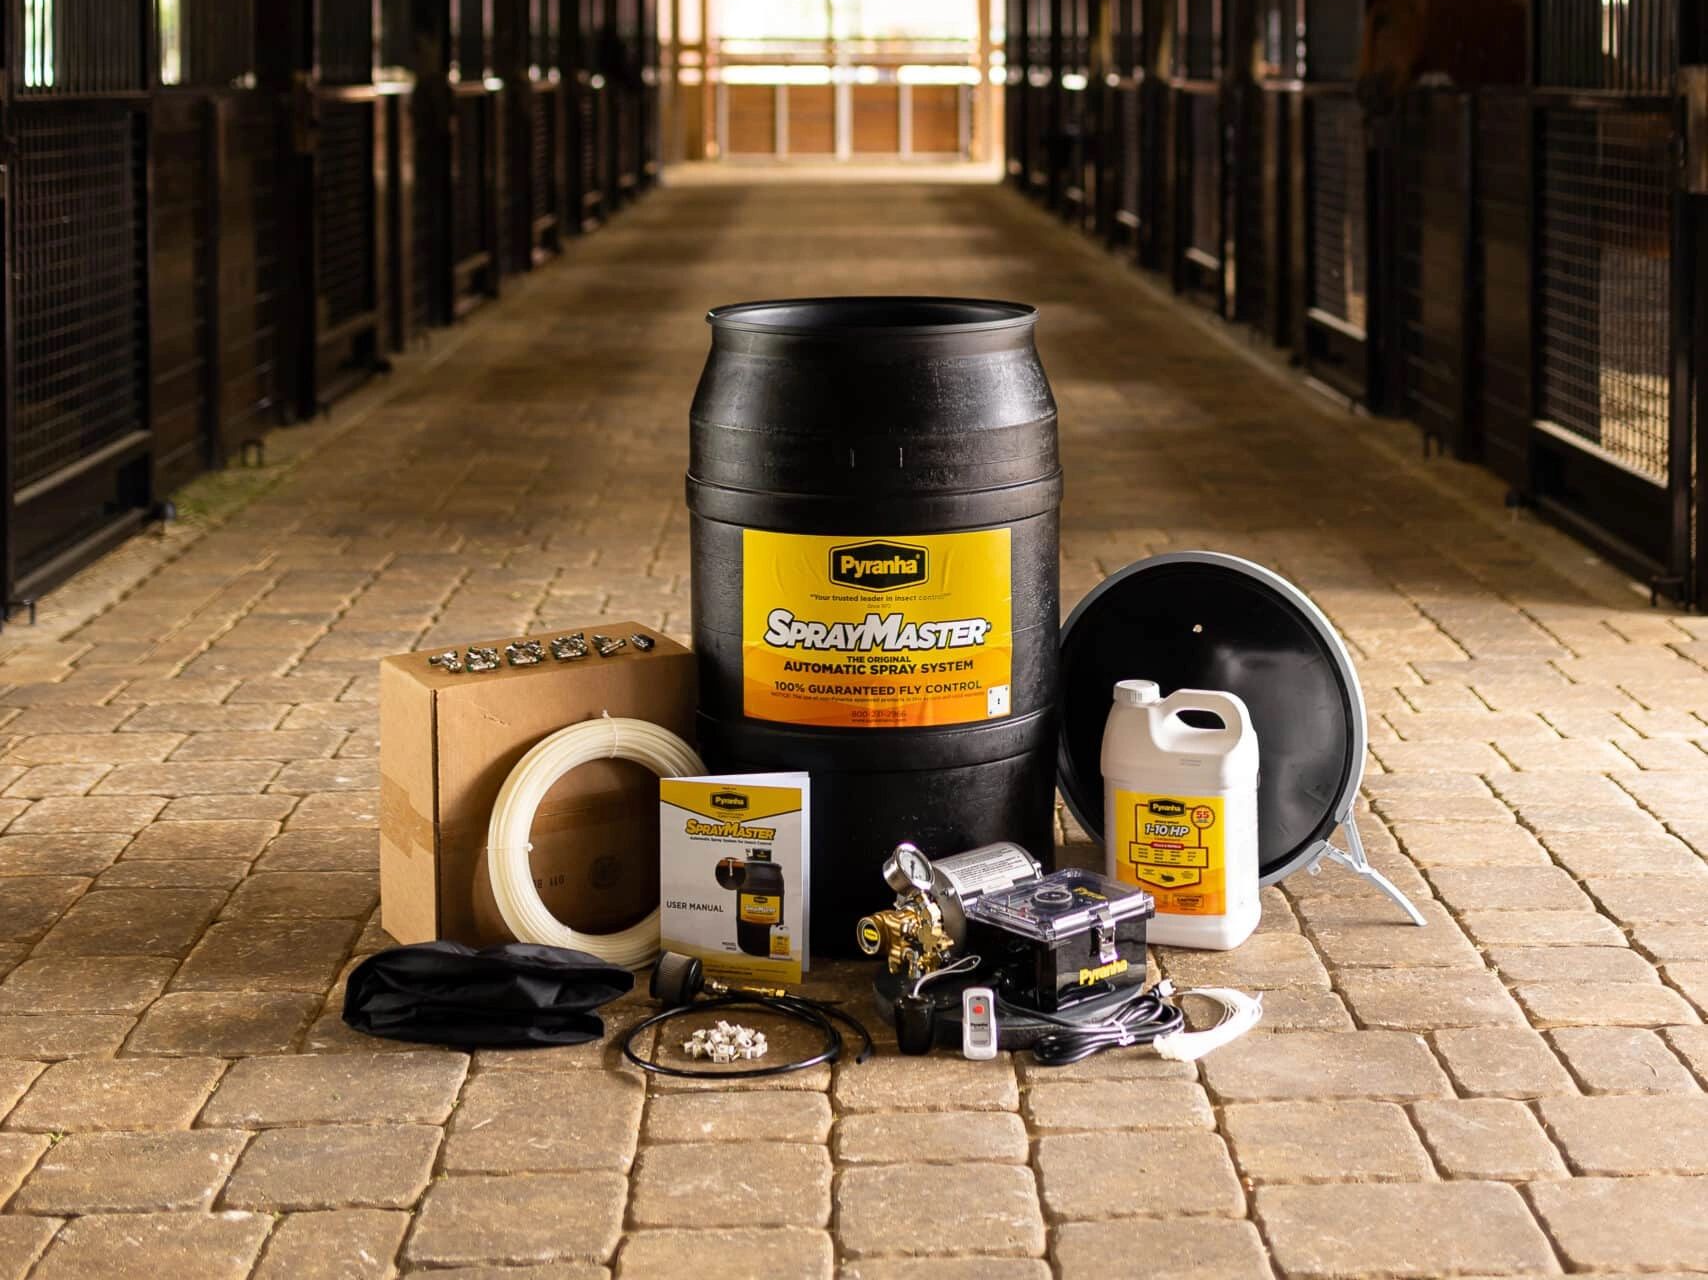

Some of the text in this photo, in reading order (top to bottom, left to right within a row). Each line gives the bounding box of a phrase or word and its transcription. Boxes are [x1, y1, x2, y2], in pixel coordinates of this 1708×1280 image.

[840, 555, 918, 578] Pyranha
[847, 655, 912, 663] THE ORIGINAL
[784, 660, 974, 675] AUTOMATIC SPRAY SYSTEM
[775, 680, 982, 696] 100% GUARANTEED FLY CONTROL
[1145, 823, 1190, 837] 1-10 HP
[666, 900, 724, 913] USER MANUAL
[1080, 960, 1128, 986] Pyranha
